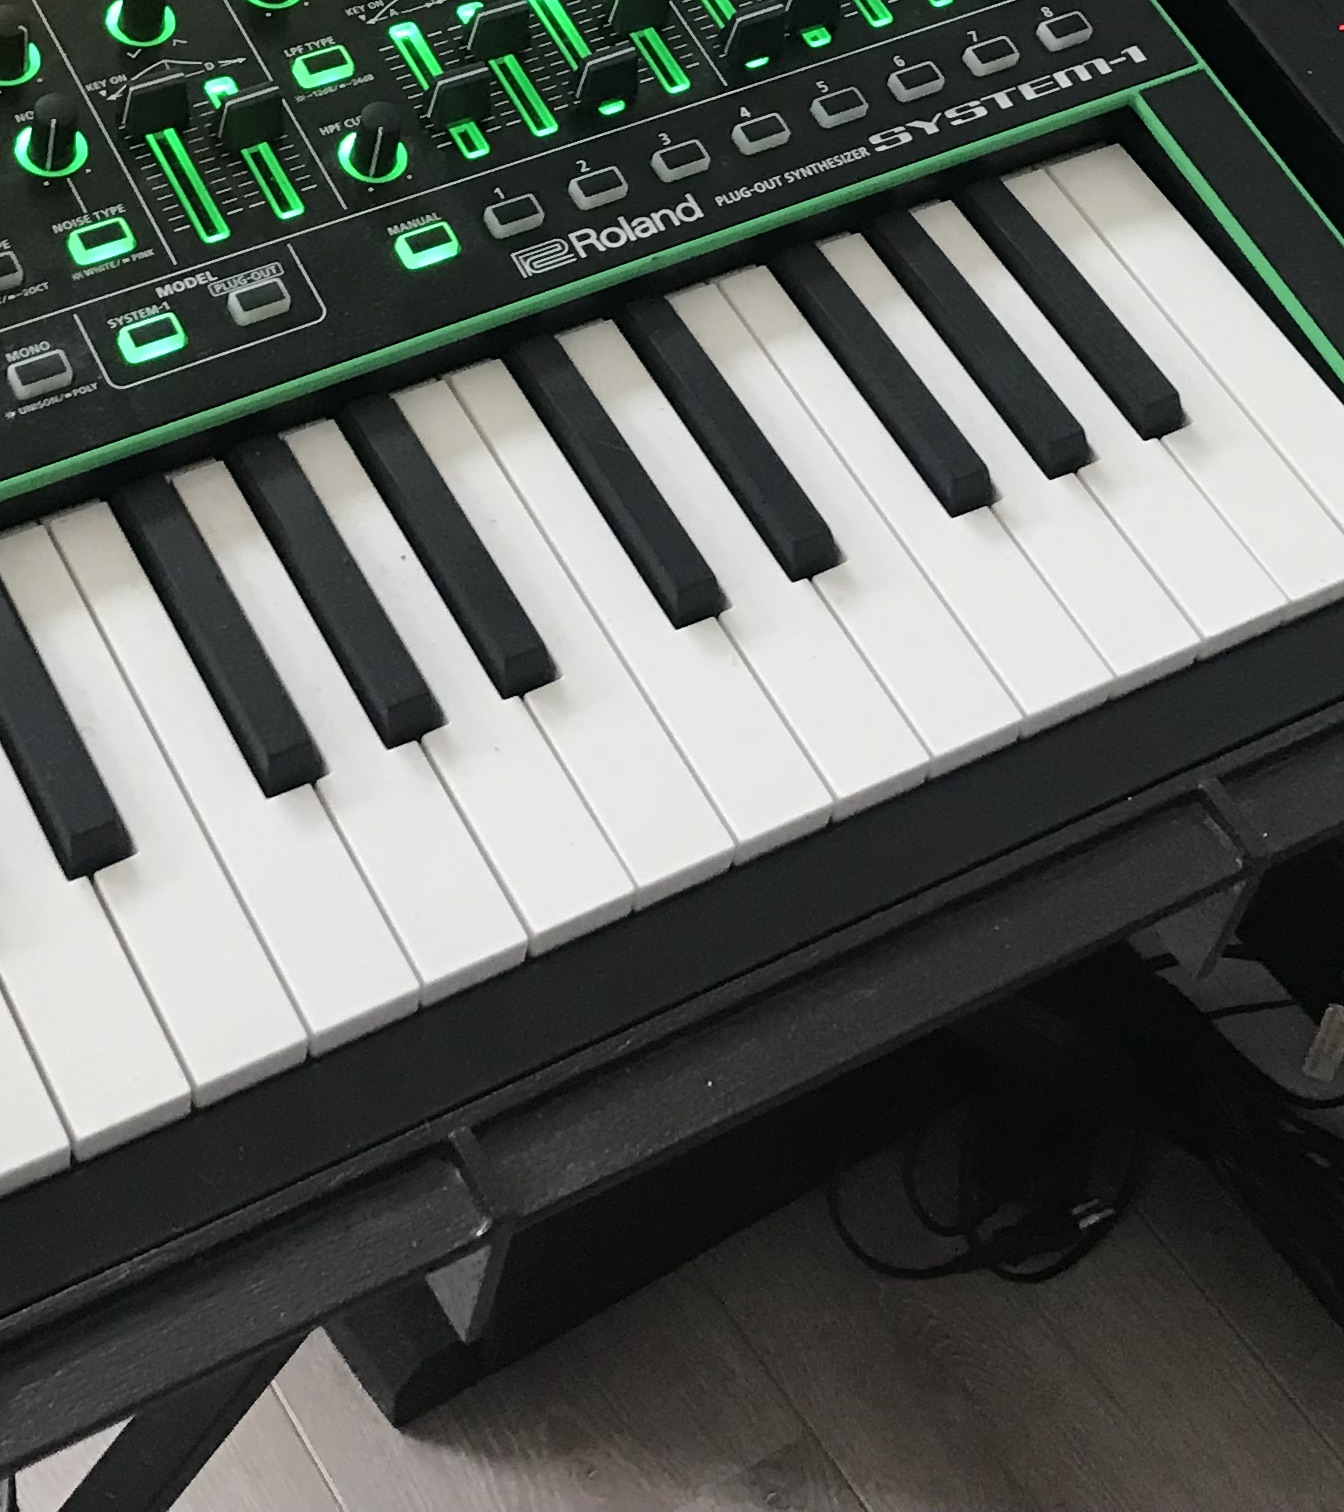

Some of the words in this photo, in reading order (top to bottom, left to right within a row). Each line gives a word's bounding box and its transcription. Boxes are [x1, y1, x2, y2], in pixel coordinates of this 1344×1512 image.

[283, 44, 308, 58] LPF
[308, 35, 337, 50] TYPE
[568, 193, 705, 260] Roland
[713, 174, 785, 208] PLUG-OUT
[783, 146, 872, 186] SYNTHESIZER
[867, 44, 1149, 153] SYSTEM-1
[51, 215, 91, 235] NOISE
[91, 203, 127, 223] TYPE
[386, 210, 442, 238] MANUAL
[155, 271, 219, 300] MODEL
[213, 264, 280, 295] PLUG-OUT
[106, 301, 173, 330] SYSTEM-1
[4, 340, 51, 364] MONO
